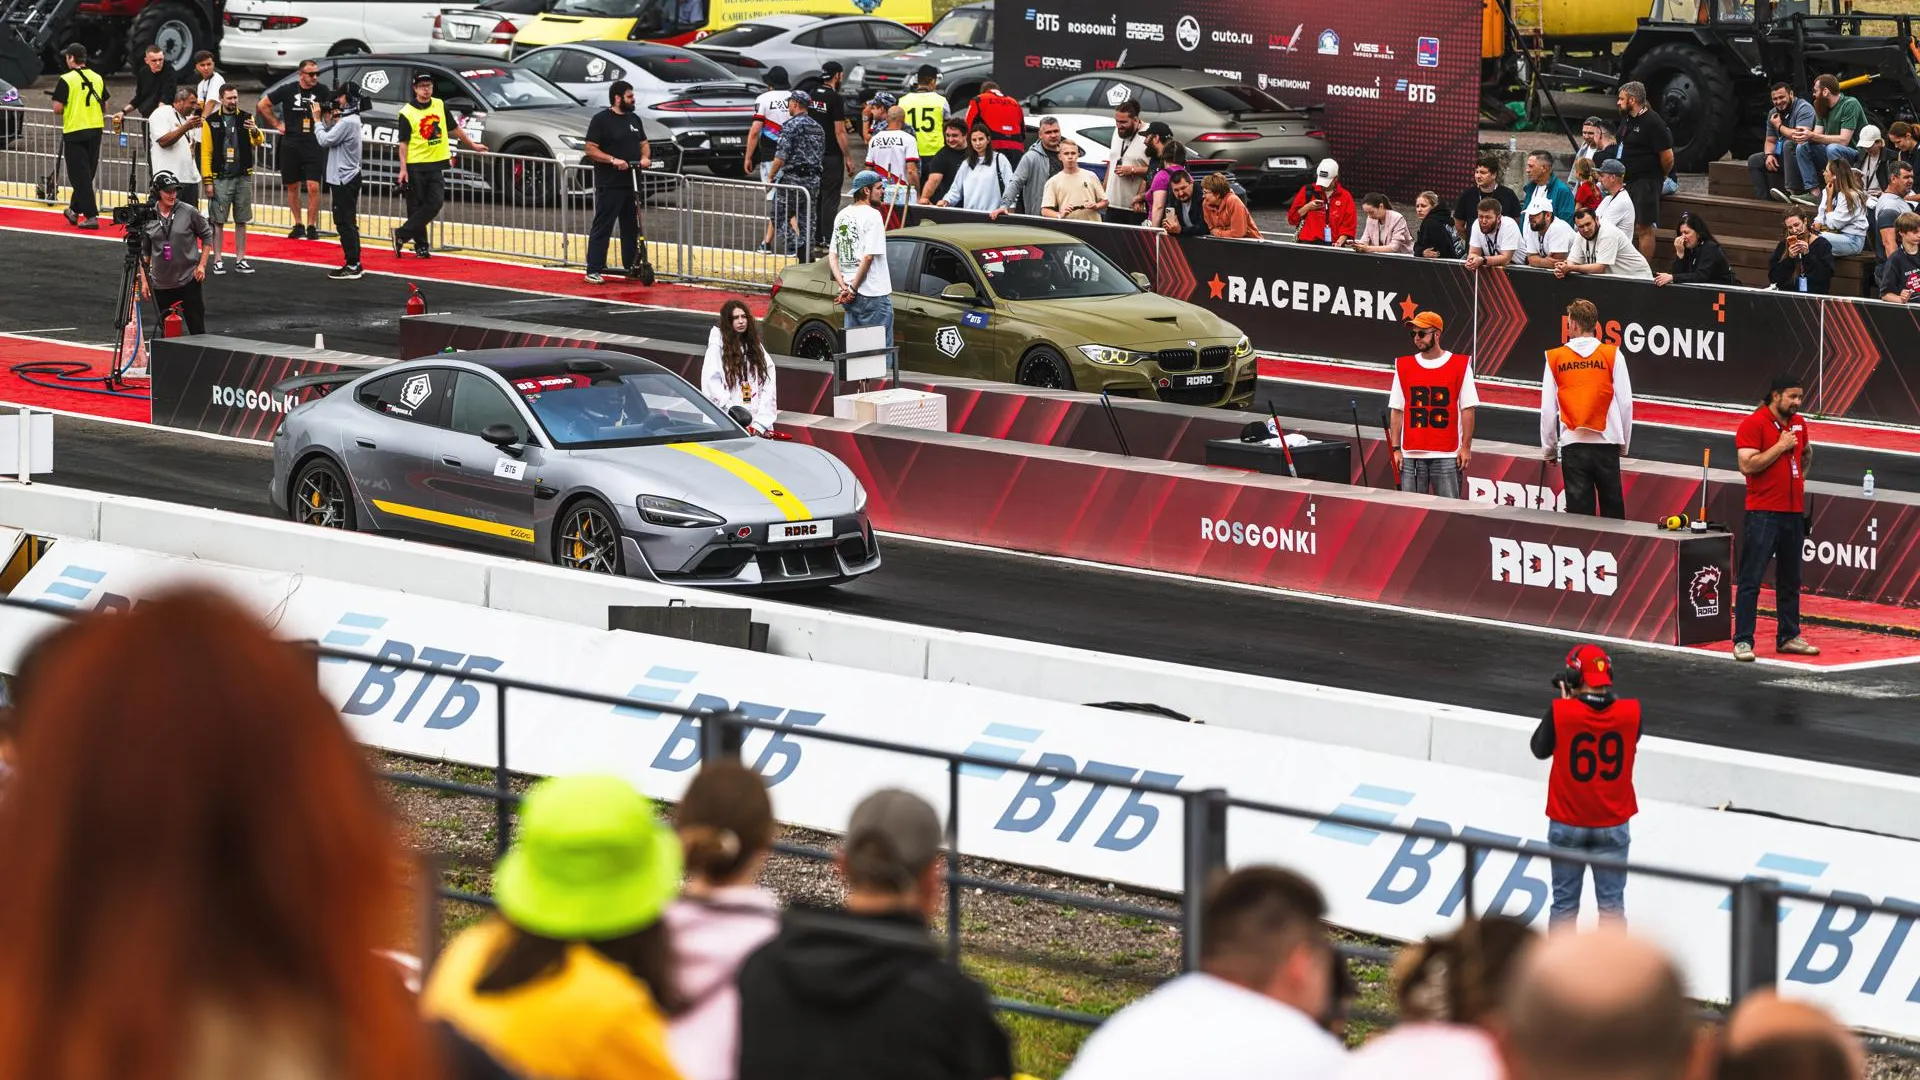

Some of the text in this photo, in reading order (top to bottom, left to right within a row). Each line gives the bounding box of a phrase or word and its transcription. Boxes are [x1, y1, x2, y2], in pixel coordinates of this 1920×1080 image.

[1036, 14, 1060, 32] ВТБ
[1068, 22, 1116, 37] ROSGONKI
[1211, 31, 1253, 44] auto.ru
[1267, 77, 1311, 90] ЧЕМПИОНАТ
[1327, 84, 1380, 99] ROSGONKI
[81, 81, 93, 107] 7
[1408, 84, 1436, 103] ВТБ
[907, 107, 935, 132] 15
[982, 251, 999, 260] 13
[1227, 275, 1398, 322] RACEPARK
[946, 335, 956, 346] 13
[1557, 359, 1607, 373] MARSHAL
[1186, 375, 1213, 386] RDRC
[412, 384, 424, 395] 82
[1409, 385, 1450, 408] RD
[1409, 408, 1449, 429] RC
[504, 464, 517, 474] ВТБ
[509, 528, 532, 540] Ultra
[784, 524, 818, 537] RDRC
[1201, 517, 1316, 555] ROSGONKI
[1489, 536, 1618, 597] RDRC
[1697, 606, 1719, 617] RDRC
[341, 639, 505, 730] ВТБ
[1569, 731, 1625, 783] 69
[993, 752, 1185, 852] ВТБ
[1785, 888, 1920, 1004] ВТ
